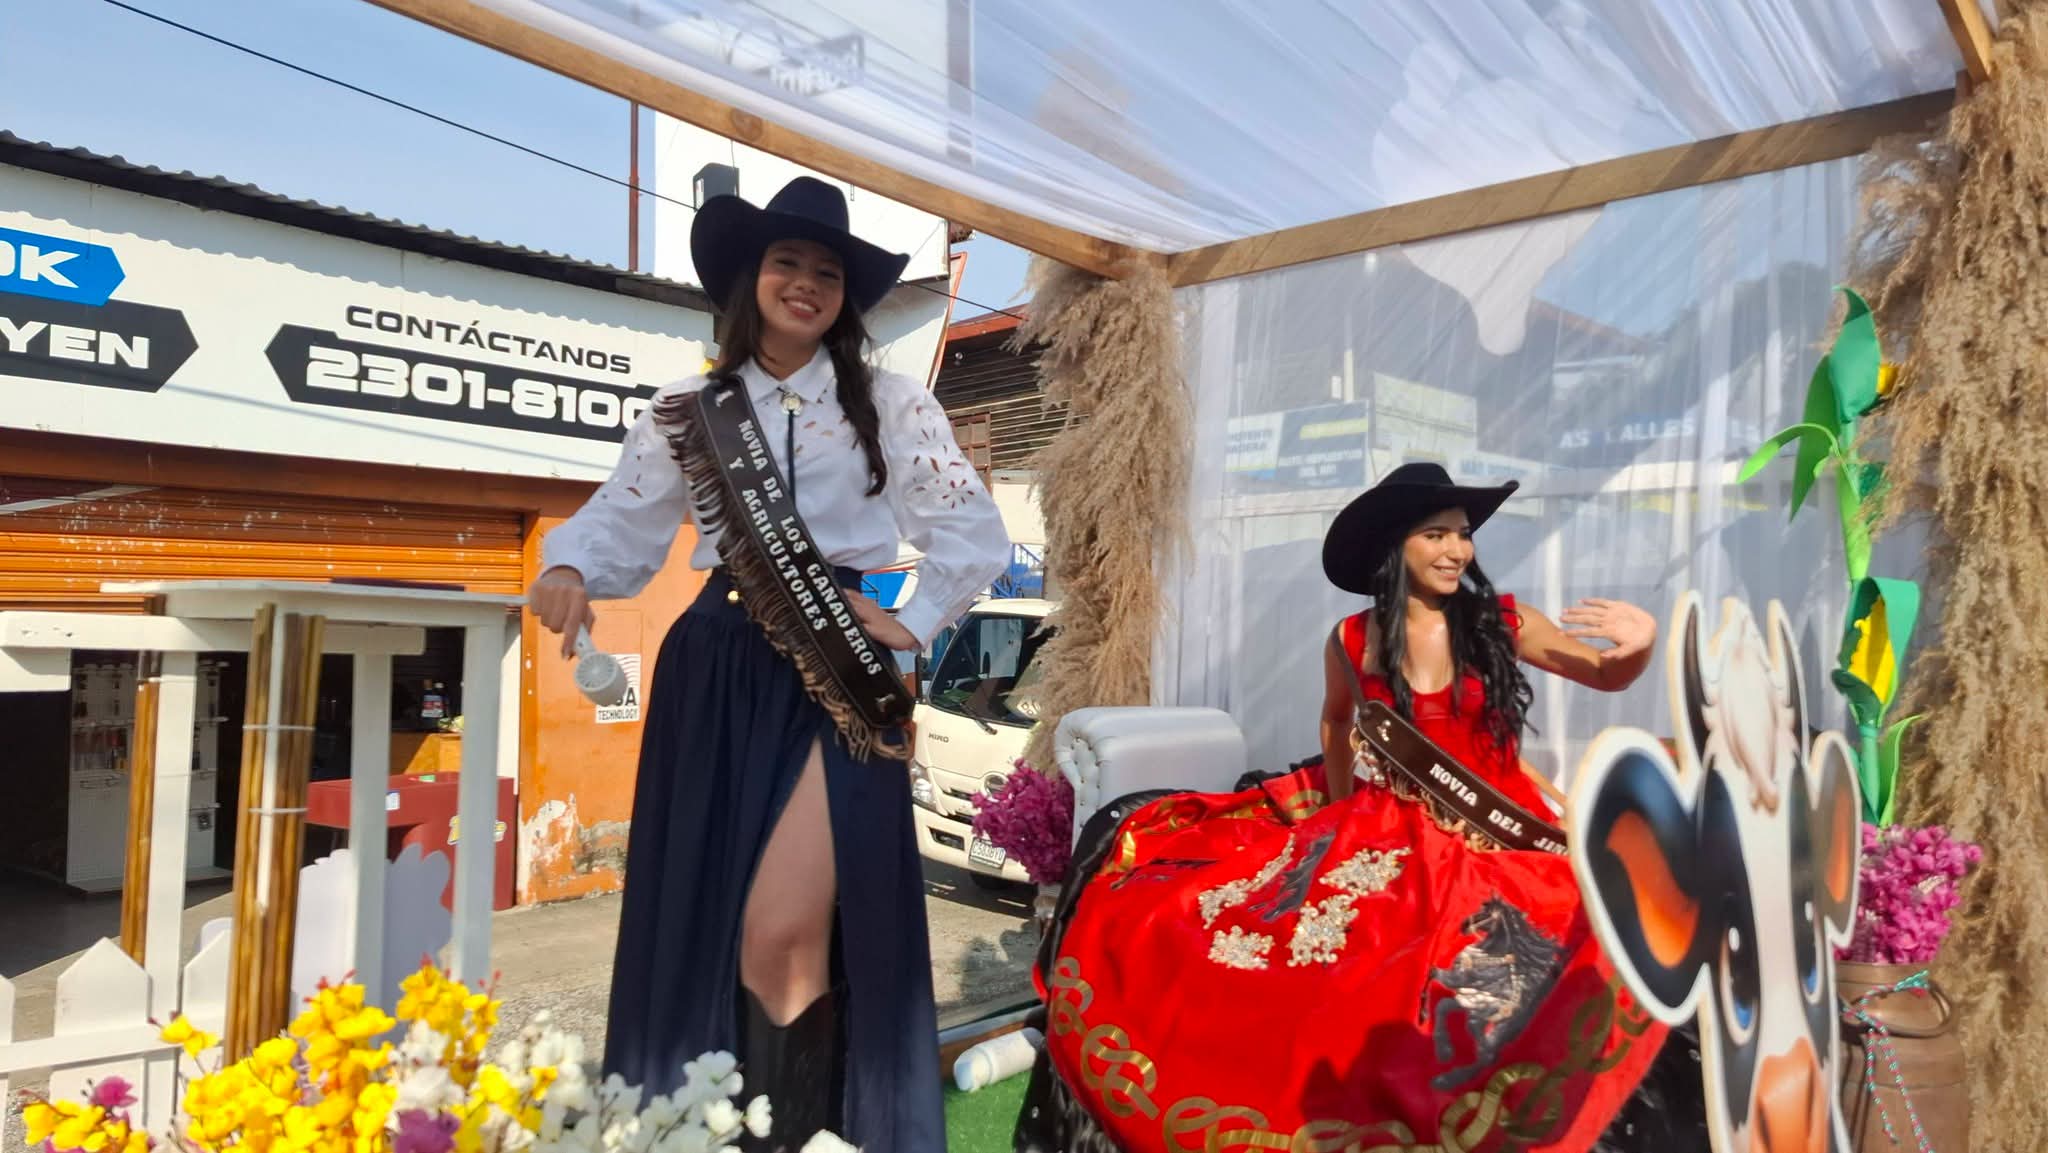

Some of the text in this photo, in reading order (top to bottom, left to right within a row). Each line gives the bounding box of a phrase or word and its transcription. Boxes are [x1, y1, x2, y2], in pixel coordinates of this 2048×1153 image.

[346, 304, 632, 375] CONTÁCTANOS
[729, 456, 828, 631] Y AGRICULTORES
[738, 419, 882, 675] NOVIA DE LOS GANADEROS
[598, 708, 638, 720] TECHNOLOGY
[1429, 763, 1569, 857] NOVIA DEL JIN
